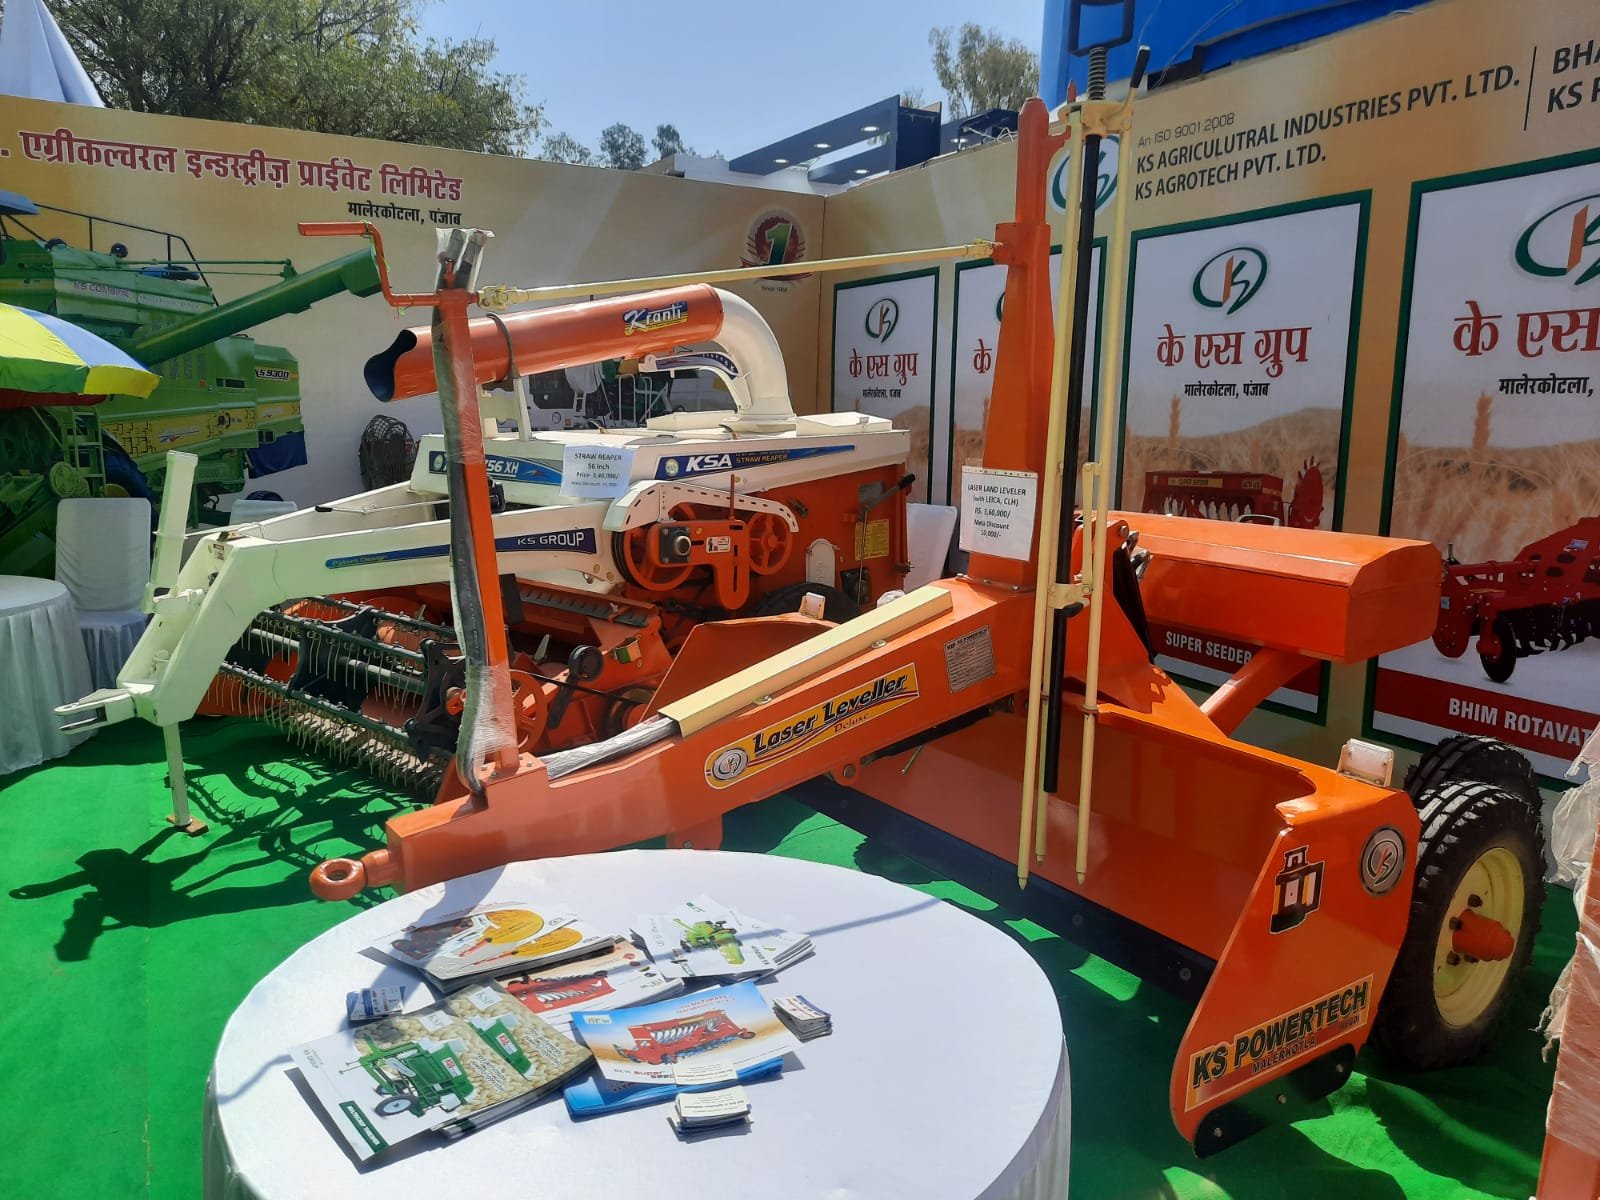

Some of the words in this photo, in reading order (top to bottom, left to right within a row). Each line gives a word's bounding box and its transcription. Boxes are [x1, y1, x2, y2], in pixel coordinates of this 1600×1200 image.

[1547, 81, 1583, 113] KS
[1137, 152, 1154, 175] KS
[1157, 123, 1279, 170] AGRICULUTRAL
[1283, 92, 1401, 140] INDUSTRIES
[1407, 79, 1457, 112] PVT.
[1465, 65, 1520, 98] LTD.
[1154, 129, 1171, 144] ISO
[19, 128, 178, 173] एग्रीकल्चरल
[297, 157, 372, 192] प्राईवेट
[379, 163, 463, 201] लिमिटेड
[1135, 181, 1152, 201] KS
[1155, 162, 1239, 197] AGROTECH
[1243, 153, 1281, 179] PVT.
[1285, 143, 1326, 170] LTD.
[428, 207, 462, 226] पंजाब
[624, 303, 682, 331] Kranti
[1453, 300, 1503, 356] के
[973, 339, 992, 374] के
[1157, 323, 1186, 366] के
[1194, 332, 1246, 368] एस
[1254, 327, 1312, 378] ग्रुप
[849, 348, 863, 378] के
[867, 354, 890, 379] एस
[893, 353, 919, 386] ग्रुप
[1243, 380, 1271, 397] पंजाब
[504, 461, 519, 474] XH
[686, 454, 732, 472] KSA
[736, 455, 761, 464] STRAW
[983, 485, 999, 494] LAND
[999, 487, 1026, 496] LEVELER
[517, 534, 535, 545] KS
[540, 531, 585, 547] GROUP
[1166, 631, 1202, 653] SUPER
[1206, 641, 1252, 665] SEEDER
[752, 712, 818, 757] Laser
[823, 673, 909, 723] Leveller
[834, 712, 871, 734] Deluxe
[1449, 698, 1498, 726] BHIM
[1192, 1046, 1229, 1089] KS
[1233, 981, 1368, 1070] POWERTECH
